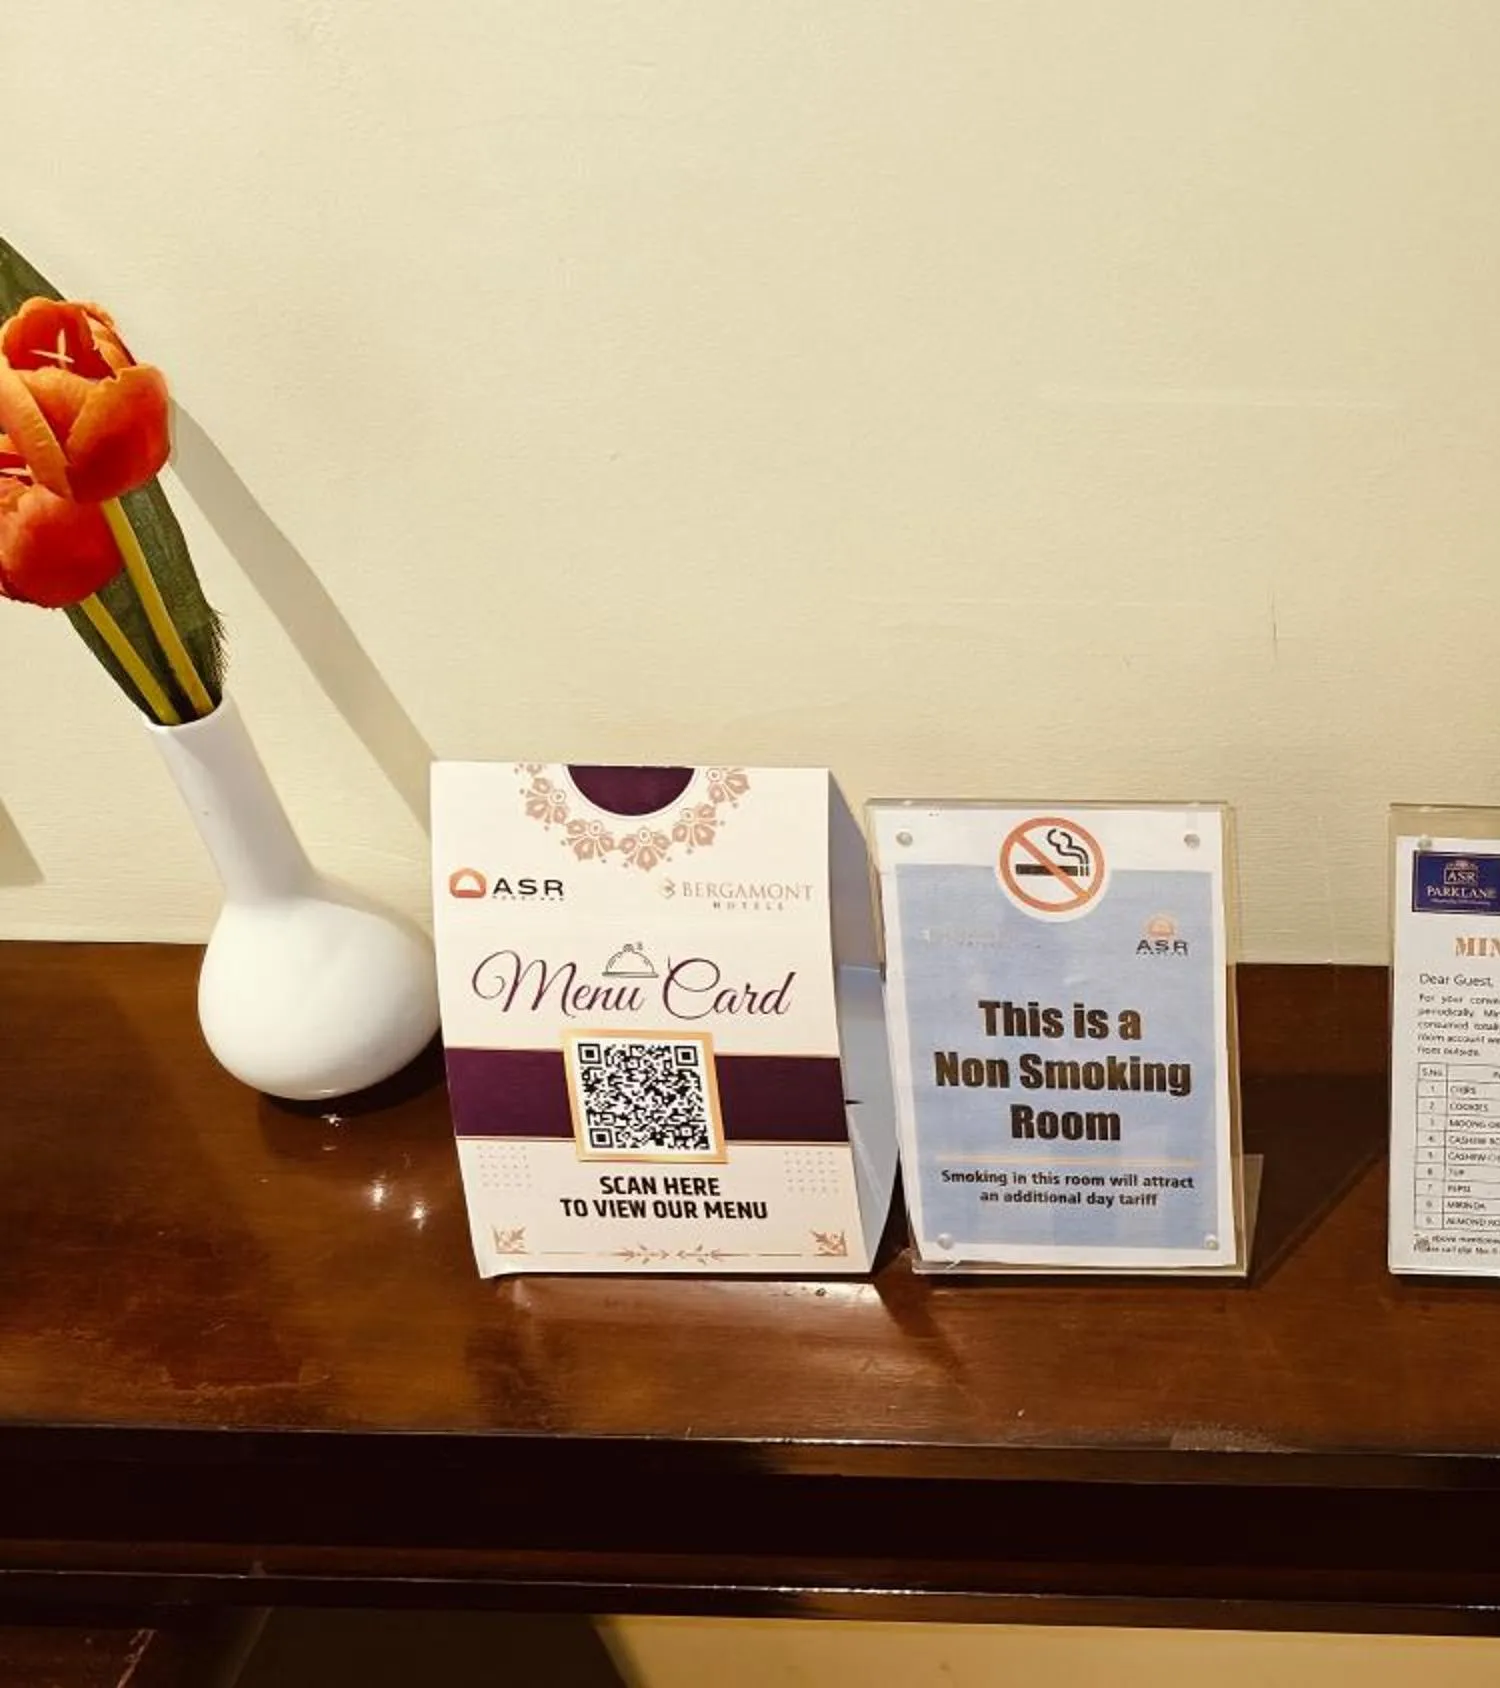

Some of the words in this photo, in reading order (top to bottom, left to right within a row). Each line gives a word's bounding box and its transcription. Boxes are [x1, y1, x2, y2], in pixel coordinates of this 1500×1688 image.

[493, 877, 564, 896] ASR
[682, 881, 813, 901] BERGAMONT
[1136, 940, 1188, 953] ASR
[472, 950, 644, 1018] Menu
[662, 956, 797, 1020] Card
[1419, 973, 1449, 986] Dear
[1453, 975, 1494, 988] Guest,
[978, 1000, 1065, 1039] This
[1073, 1003, 1109, 1040] is
[1118, 1009, 1142, 1041] a
[934, 1051, 1011, 1089] Non
[1019, 1053, 1192, 1097] Smoking
[1010, 1104, 1121, 1142] Room
[599, 1175, 658, 1195] SCAN
[663, 1176, 721, 1196] HERE
[941, 1169, 1008, 1186] Smoking
[1013, 1171, 1026, 1184] in
[1032, 1171, 1060, 1185] this
[1065, 1175, 1105, 1187] room
[1109, 1174, 1138, 1187] will
[1143, 1175, 1195, 1189] attract
[560, 1198, 589, 1217] TO
[592, 1199, 647, 1218] VIEW
[653, 1200, 699, 1219] OUR
[703, 1200, 768, 1219] MENU
[979, 1191, 999, 1202] an
[1003, 1190, 1082, 1206] additional
[1086, 1192, 1113, 1209] day
[1119, 1194, 1159, 1206] tariff
